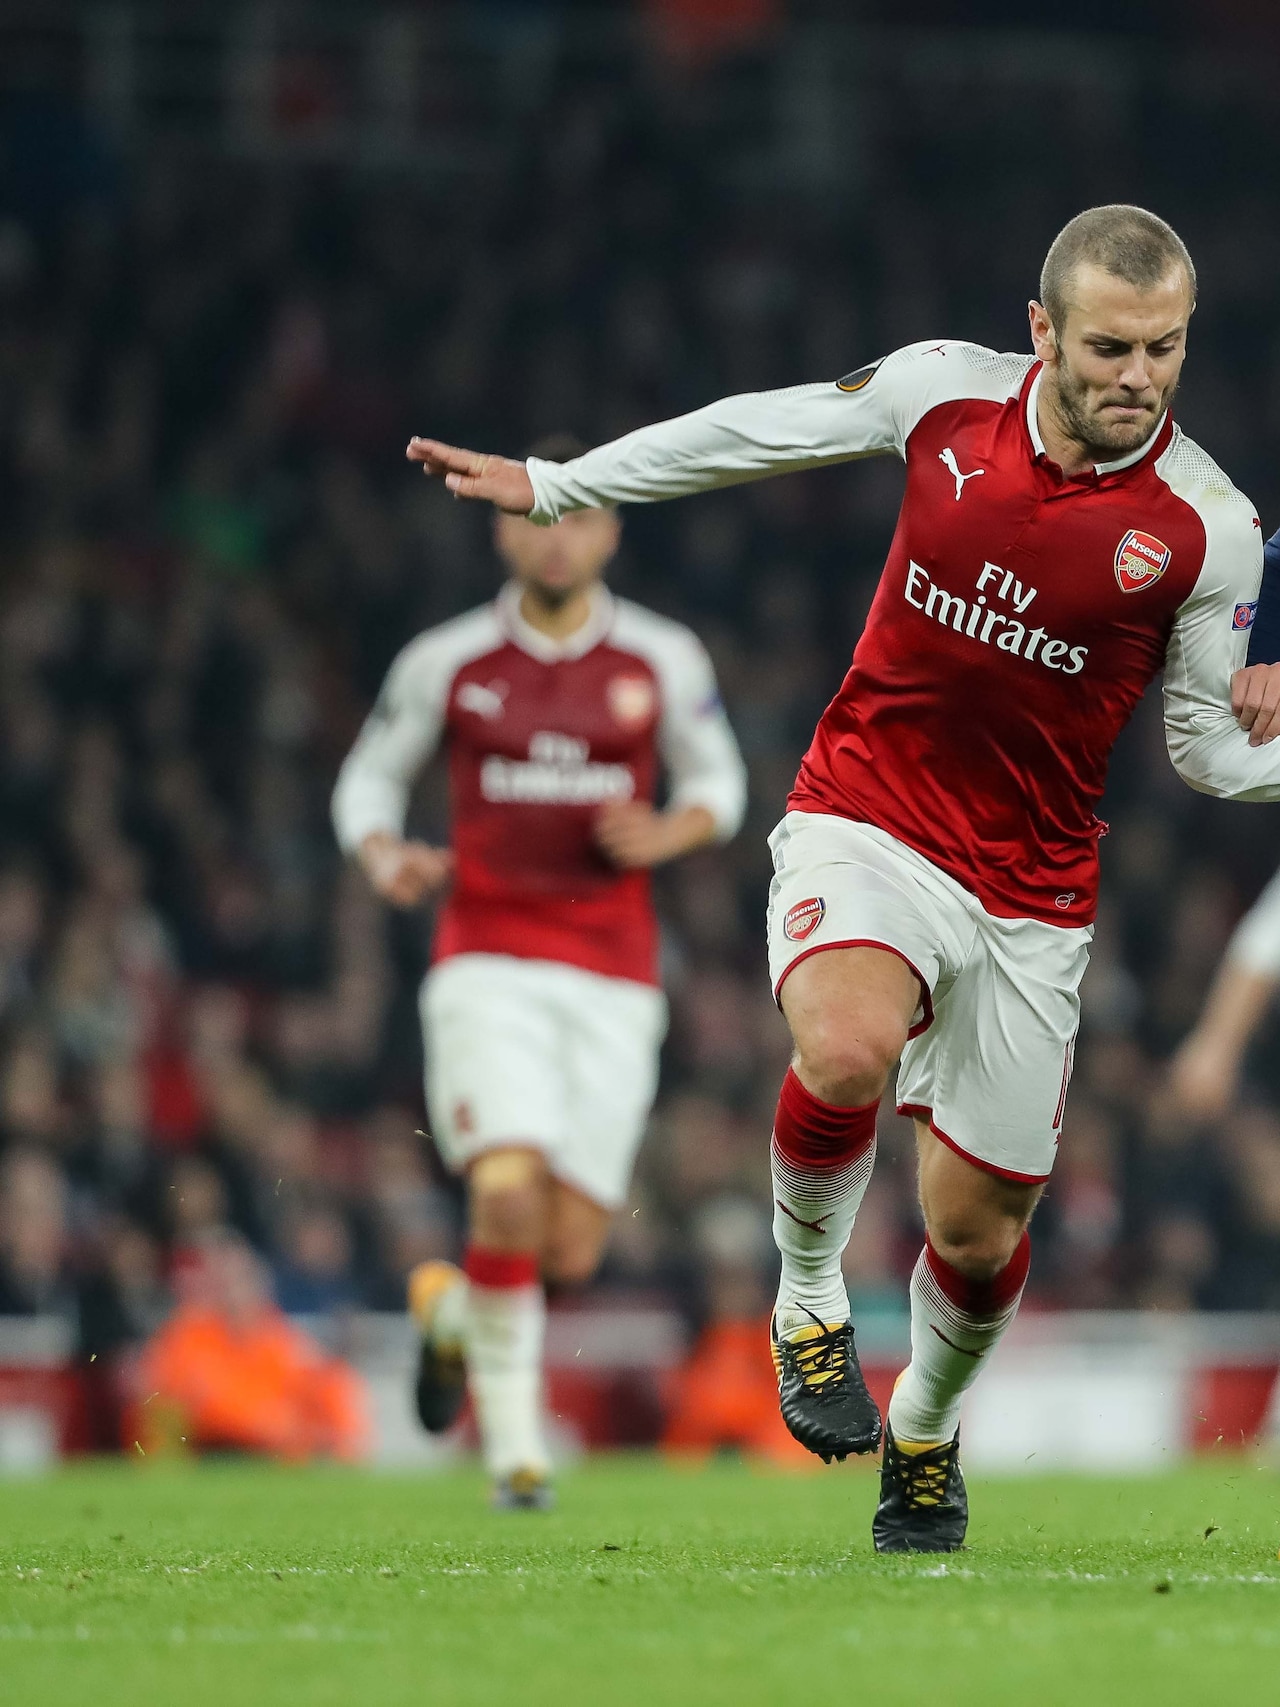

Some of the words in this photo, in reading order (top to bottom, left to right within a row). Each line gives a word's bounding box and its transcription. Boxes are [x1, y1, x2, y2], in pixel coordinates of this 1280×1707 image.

[1127, 537, 1164, 563] Arsenal
[976, 561, 1038, 614] Fly
[904, 559, 1089, 675] Emirates
[787, 901, 819, 921] Arsenal
